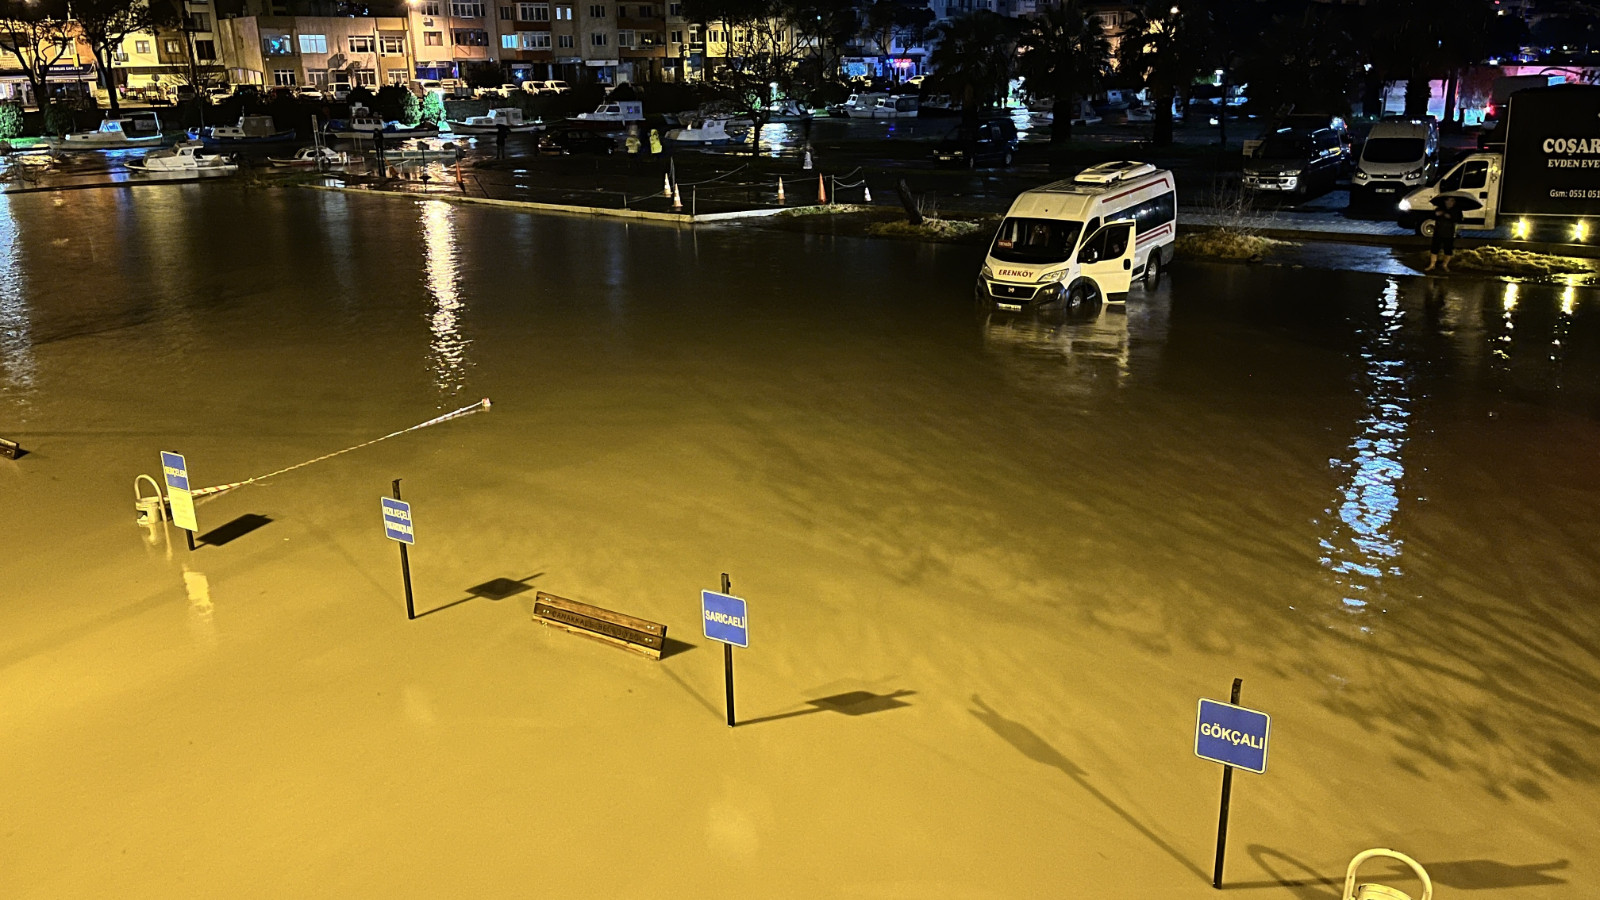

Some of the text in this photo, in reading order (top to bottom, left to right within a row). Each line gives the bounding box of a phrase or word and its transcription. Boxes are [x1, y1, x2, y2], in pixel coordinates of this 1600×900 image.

[1548, 159, 1580, 168] EVDEN
[1550, 189, 1568, 198] Gsm:
[1569, 189, 1586, 198] 0551
[998, 269, 1034, 278] ERENKÖY
[1200, 722, 1264, 750] GÖKÇALI
